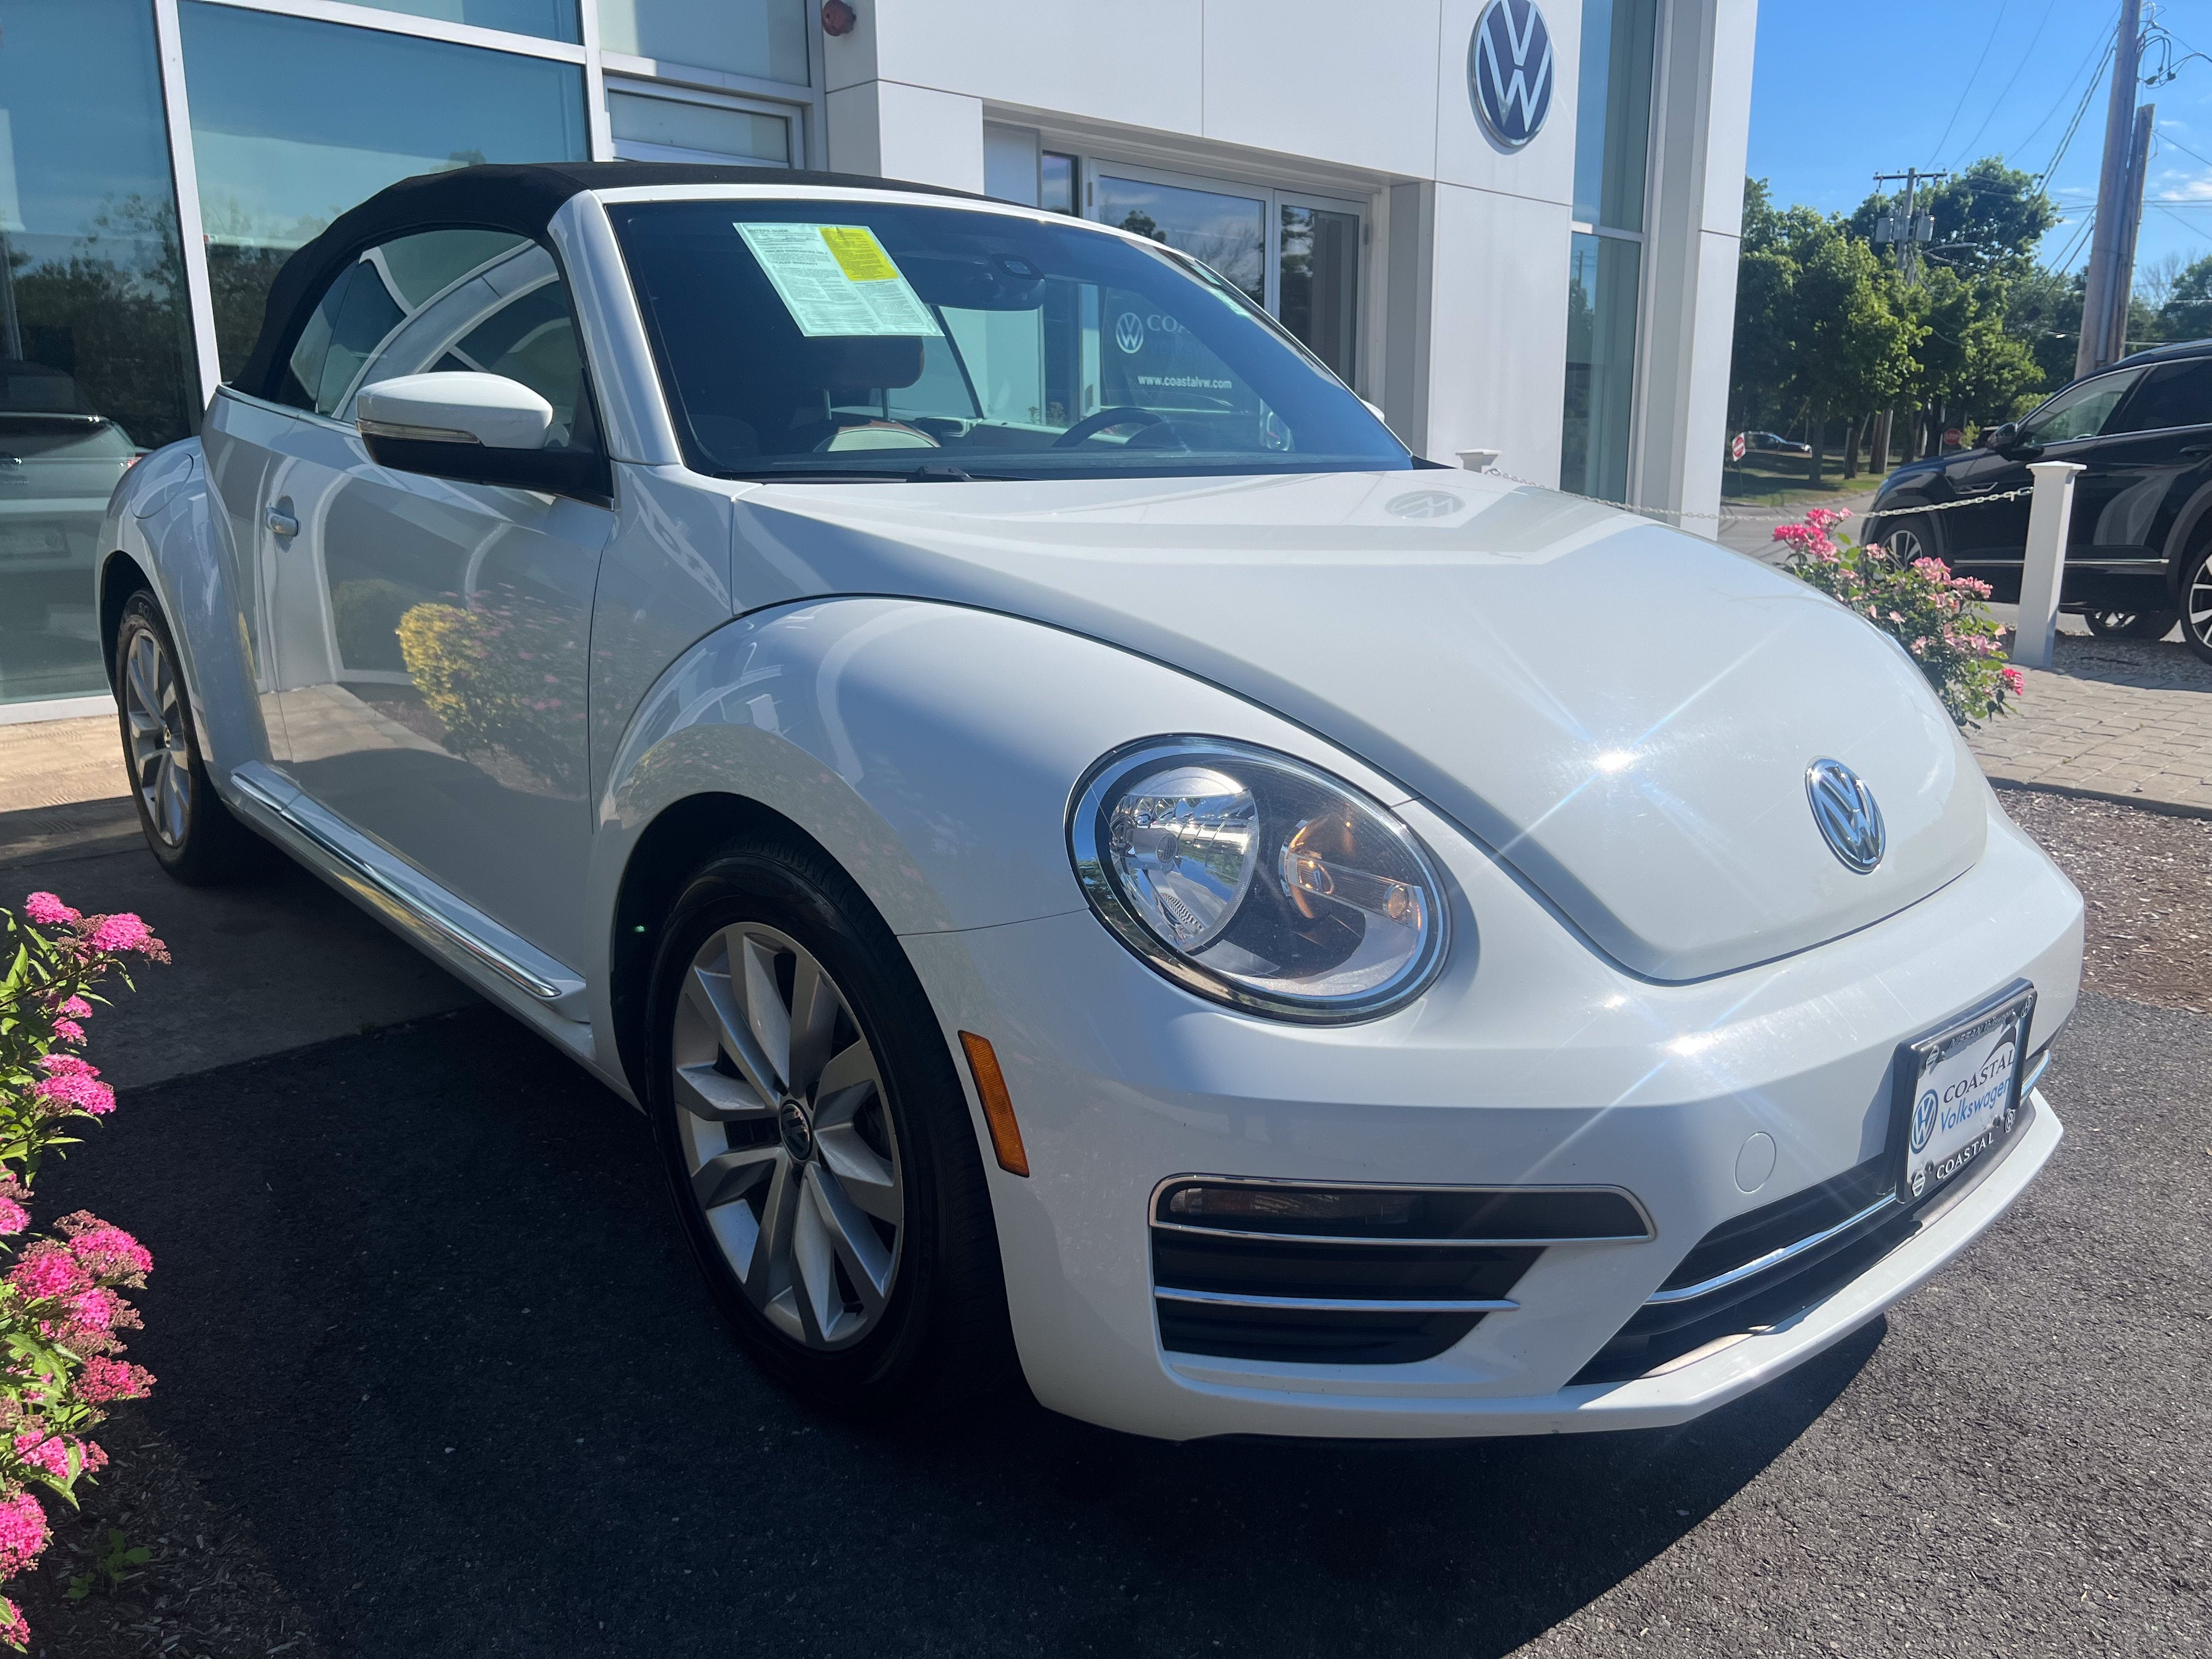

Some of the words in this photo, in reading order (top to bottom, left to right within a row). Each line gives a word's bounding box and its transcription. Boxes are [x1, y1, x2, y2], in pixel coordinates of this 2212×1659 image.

[1137, 375, 1232, 388] www.coastalvw.com
[1944, 1049, 2015, 1103] COASTAL
[1941, 1077, 2011, 1133] Volkswagen
[1936, 1132, 1994, 1180] COASTAL
